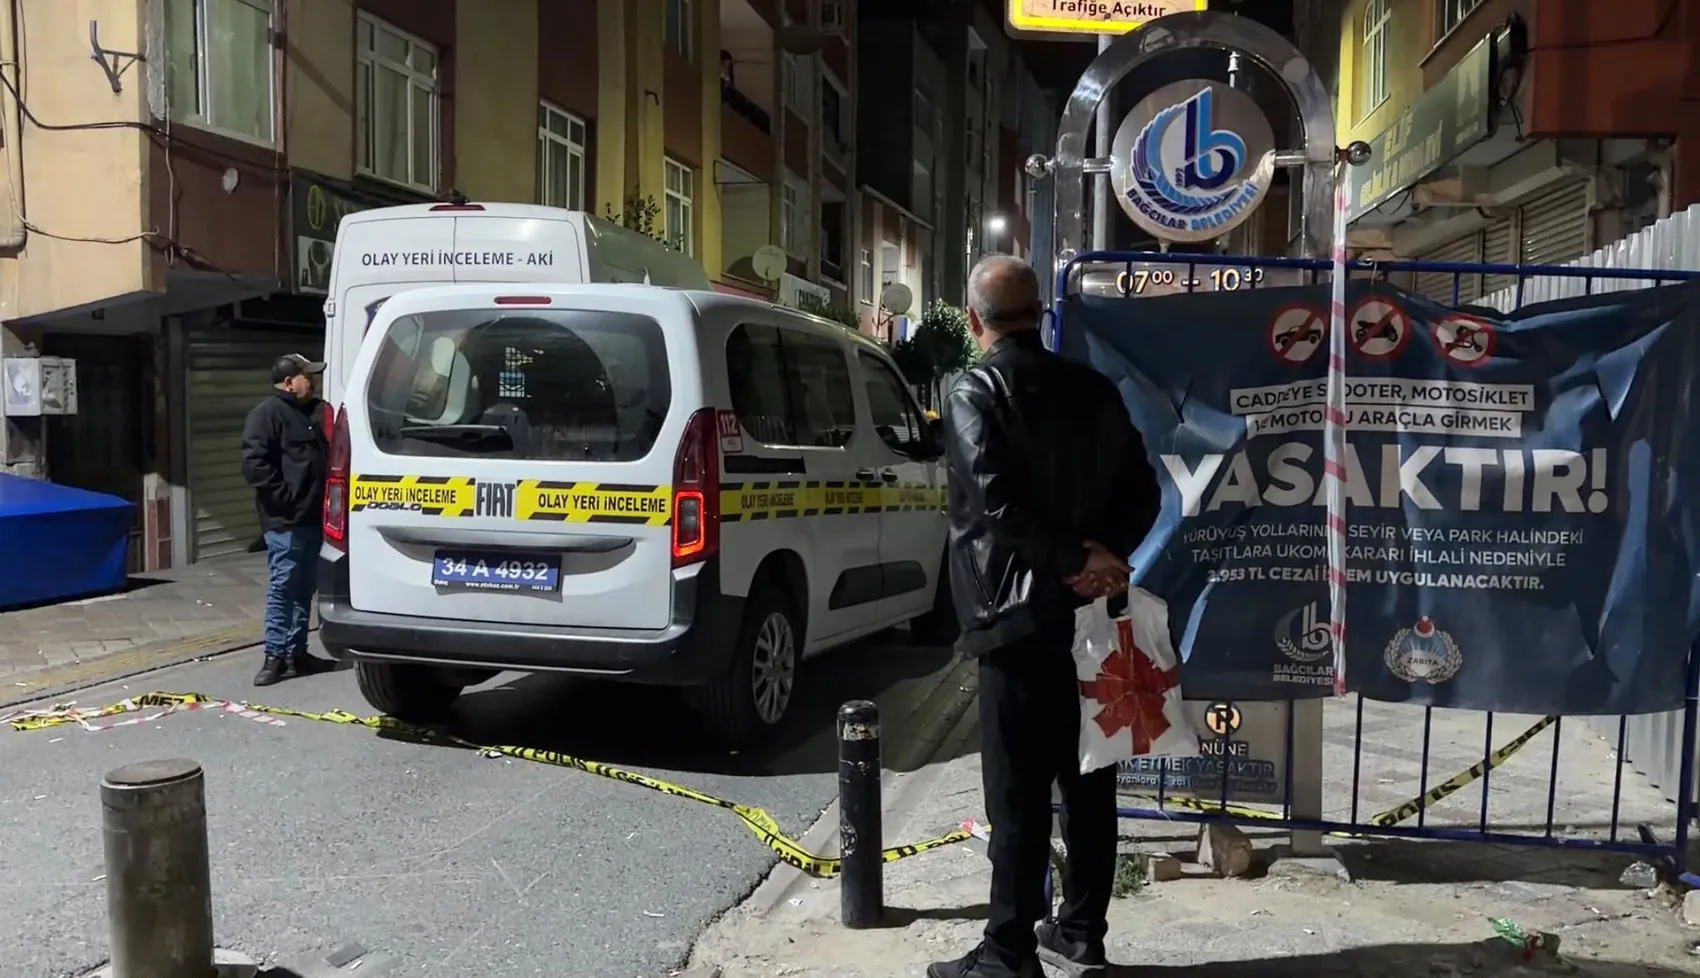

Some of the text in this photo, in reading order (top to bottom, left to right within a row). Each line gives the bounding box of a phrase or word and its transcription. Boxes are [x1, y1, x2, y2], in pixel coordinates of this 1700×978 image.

[1051, 0, 1166, 17] Trafiğe Açıktır
[1126, 187, 1187, 230] BAĞCILAR
[362, 252, 400, 267] OLAY
[403, 250, 434, 266] YERİ
[438, 250, 513, 266] İNCELEME
[526, 250, 553, 266] AKİ
[1316, 381, 1406, 401] SOTER,
[1411, 385, 1529, 405] MOTOSİKLET
[719, 413, 738, 435] 112
[1270, 407, 1353, 428] MOTOU
[1359, 409, 1436, 430] ARAÇLA
[1441, 409, 1512, 431] GİRMEK
[1159, 442, 1609, 518] YASAKTIR!
[355, 486, 378, 500] OLAY
[476, 482, 516, 518] FIAT
[538, 493, 568, 509] OLAY
[367, 501, 421, 511] DOBLO
[1250, 524, 1331, 538] YOLLARIN
[1348, 524, 1397, 540] SEYİR
[1401, 527, 1445, 542] VEYA
[1449, 529, 1492, 544] PARK
[1497, 527, 1584, 545] HALİNDEKİ
[1192, 544, 1272, 563] TAŞITLARA
[1276, 544, 1328, 559] UKOM
[1410, 545, 1465, 564] İHLALİ
[1469, 548, 1567, 567] NEDENİYLE
[441, 557, 549, 581] 34 A 4932
[1207, 564, 1545, 590] 2.953 TL CEZAİ İEM UYGULANACAKTIR.
[1274, 663, 1334, 676] BAĞCILAR
[1201, 739, 1249, 756] NÜNE
